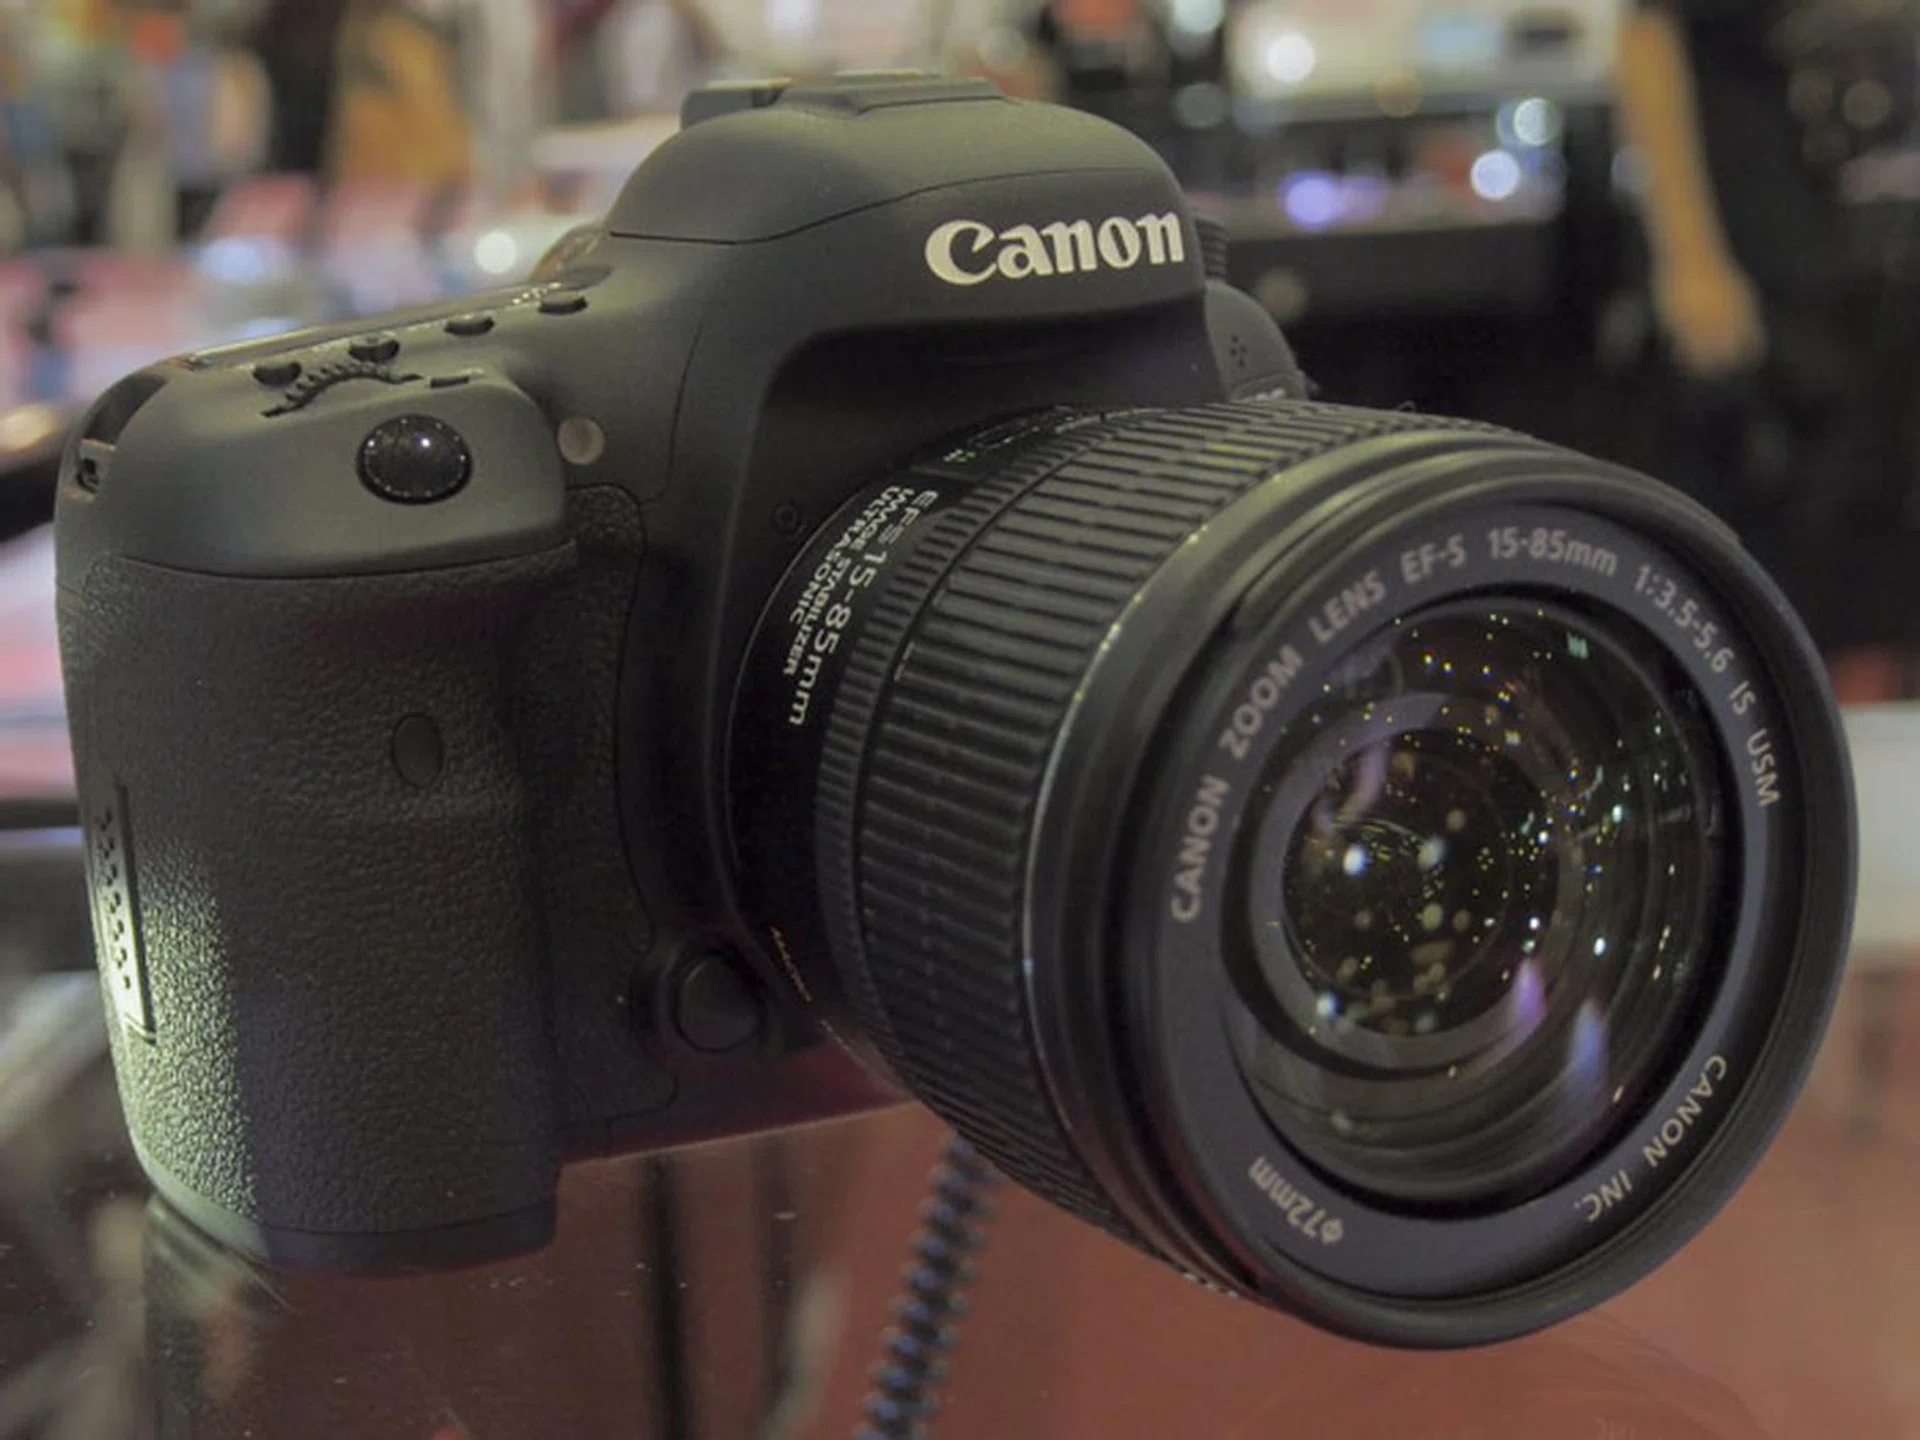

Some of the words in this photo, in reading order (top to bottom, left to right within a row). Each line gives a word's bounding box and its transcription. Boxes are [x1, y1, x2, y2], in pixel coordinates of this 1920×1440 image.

[925, 211, 1185, 286] Canon
[784, 557, 851, 676] STABILIZER
[790, 486, 901, 624] ULTRASONIC
[789, 550, 888, 726] 15-85mm
[1171, 773, 1231, 923] CANON
[1219, 644, 1303, 759] ZOOM
[1307, 570, 1387, 644] LENS
[1402, 532, 1467, 585] EF-S
[1486, 526, 1618, 577] 15-85mm
[1633, 564, 1735, 674] 1:3.5-5.6
[1729, 680, 1756, 716] IS
[1746, 728, 1781, 808] USM
[1642, 1054, 1728, 1168] CANON
